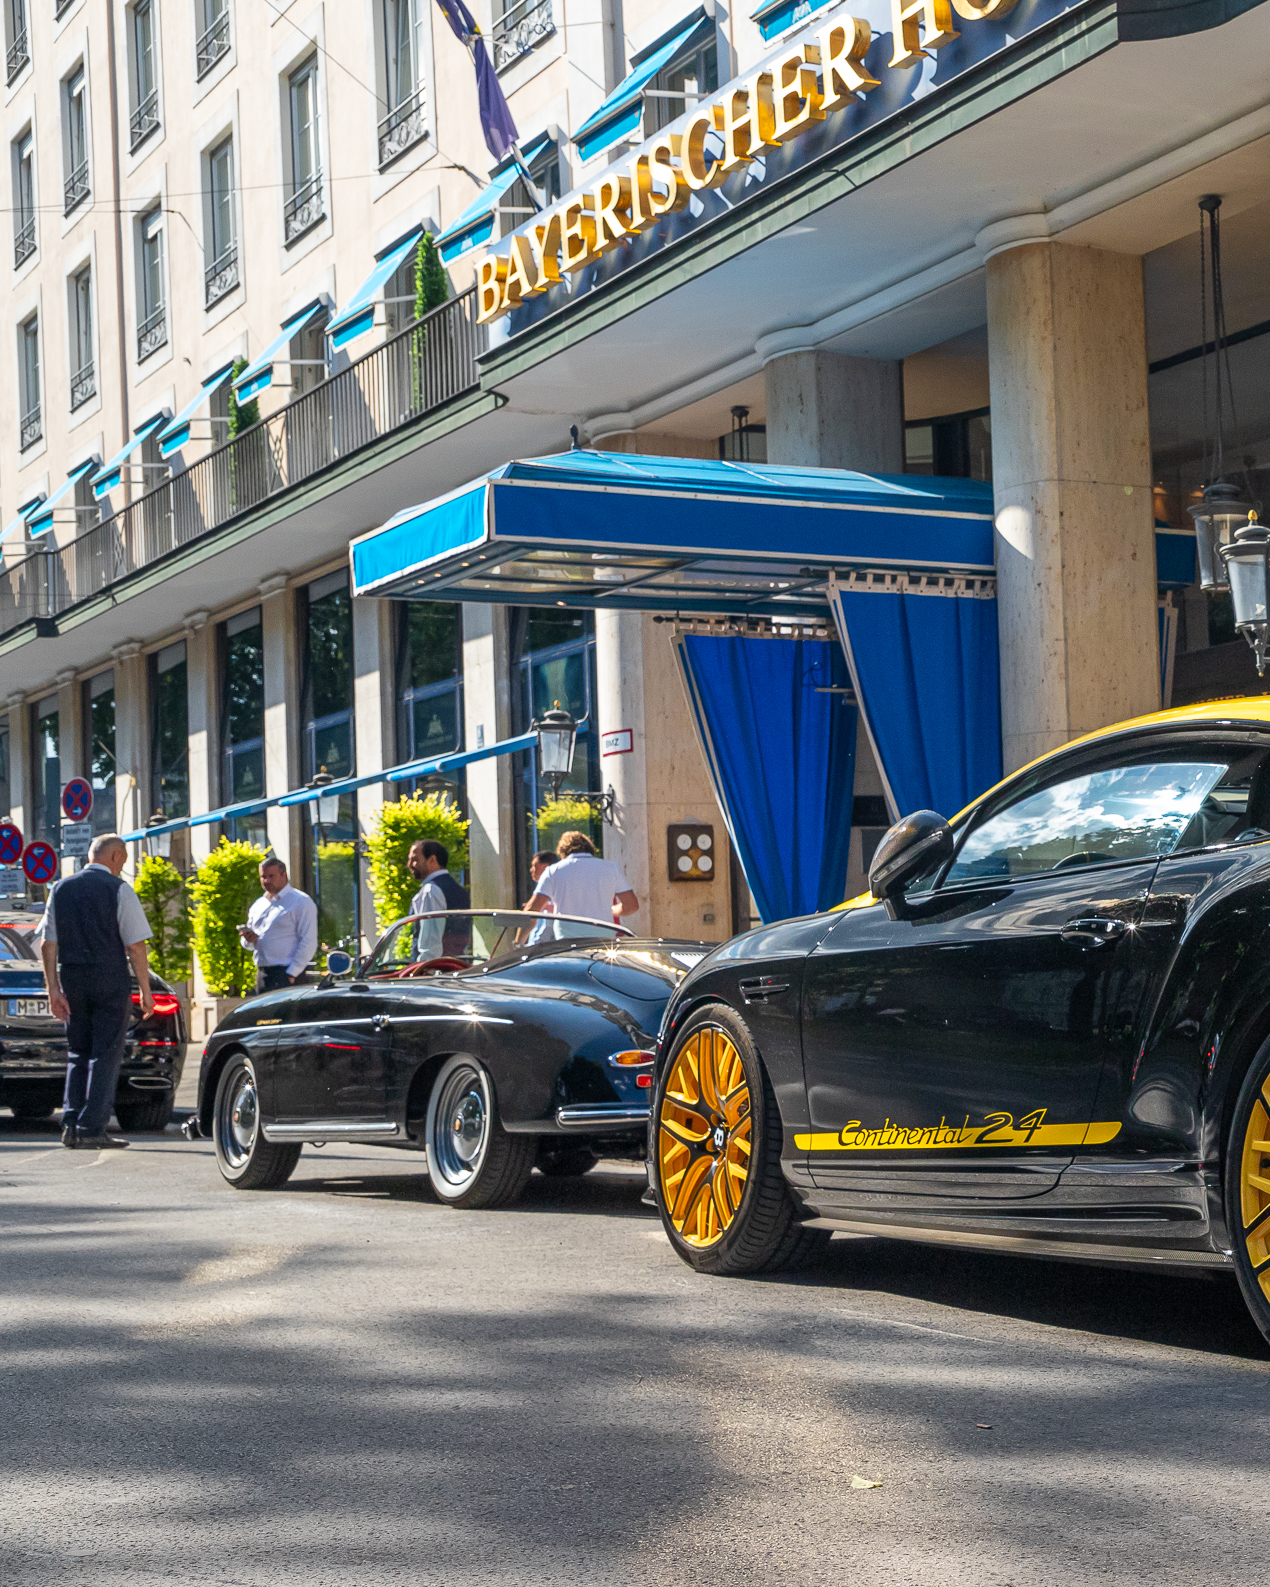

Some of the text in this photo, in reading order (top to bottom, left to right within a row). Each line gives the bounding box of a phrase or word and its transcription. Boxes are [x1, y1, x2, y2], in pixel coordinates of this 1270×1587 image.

[476, 13, 880, 325] BAYERISCHER
[18, 1000, 28, 1013] M
[838, 1108, 1048, 1147] Continental 24
